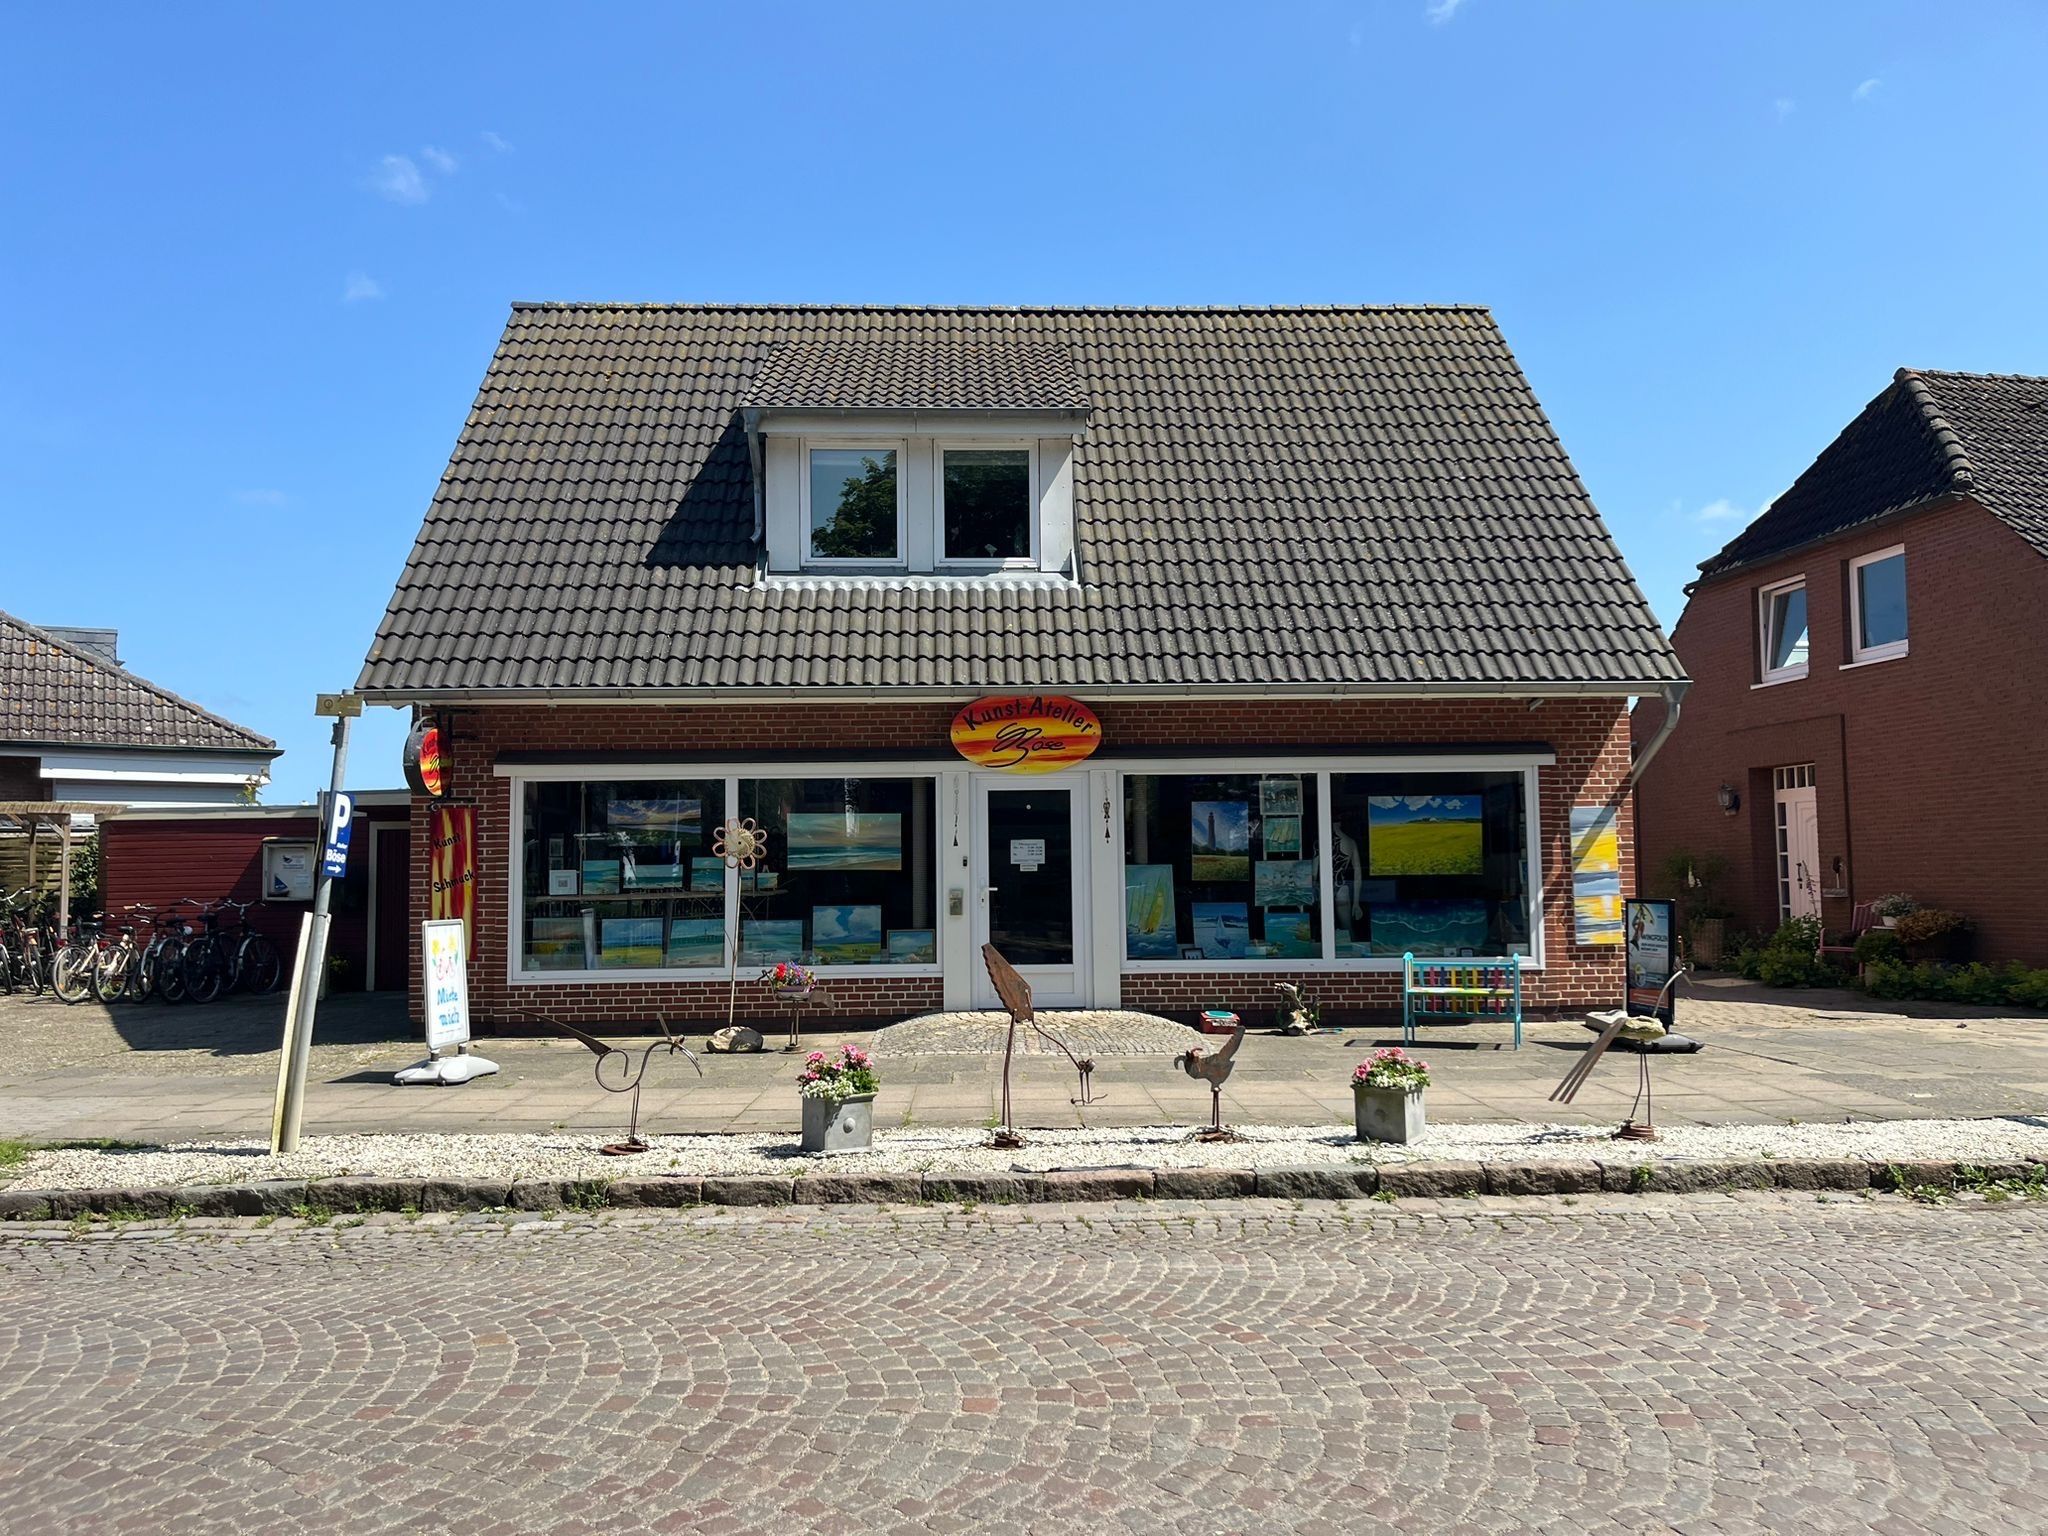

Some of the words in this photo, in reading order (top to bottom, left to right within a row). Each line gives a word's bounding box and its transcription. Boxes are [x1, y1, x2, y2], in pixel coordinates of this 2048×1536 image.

[963, 695, 1093, 732] Kunst-Atelier
[330, 793, 351, 844] P
[433, 832, 461, 849] Kunst
[326, 848, 346, 864] Böse
[433, 869, 475, 893] Schmuck
